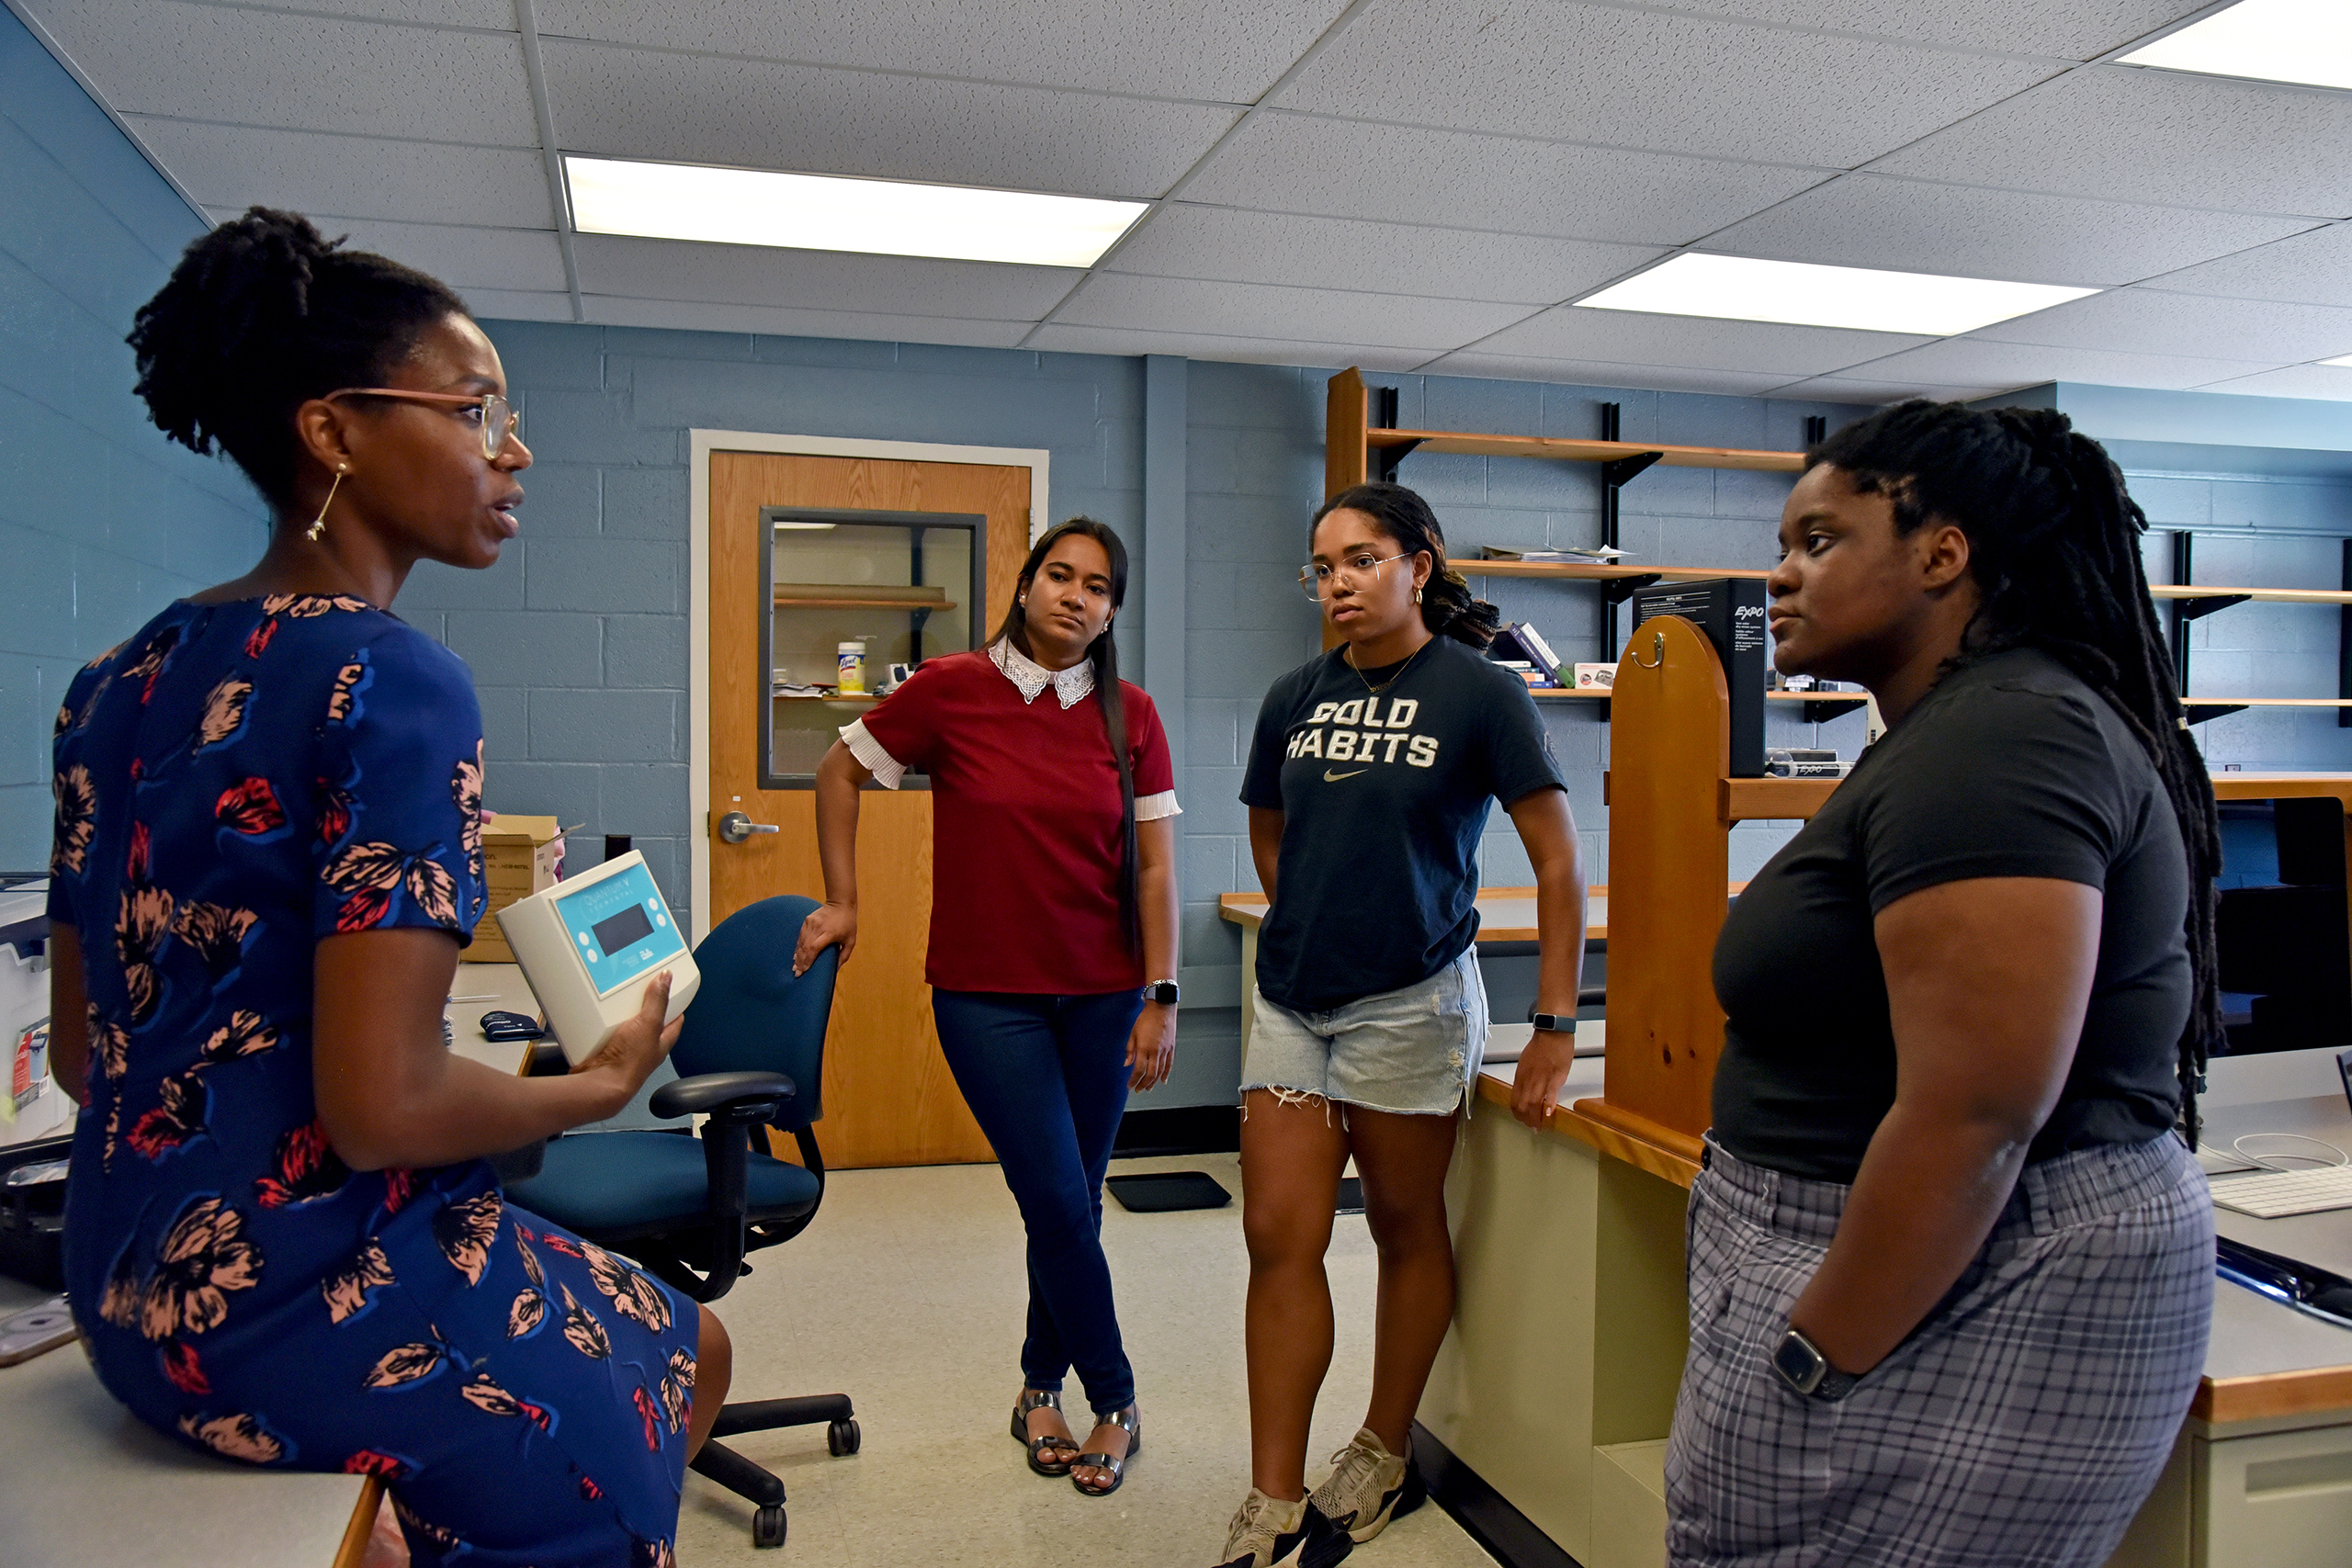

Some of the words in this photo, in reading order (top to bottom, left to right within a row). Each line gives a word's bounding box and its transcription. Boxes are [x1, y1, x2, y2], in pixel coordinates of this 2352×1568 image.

[1735, 605, 1764, 620] EXPO
[1286, 728, 1439, 768] HABITS
[1799, 765, 1823, 776] EXPO
